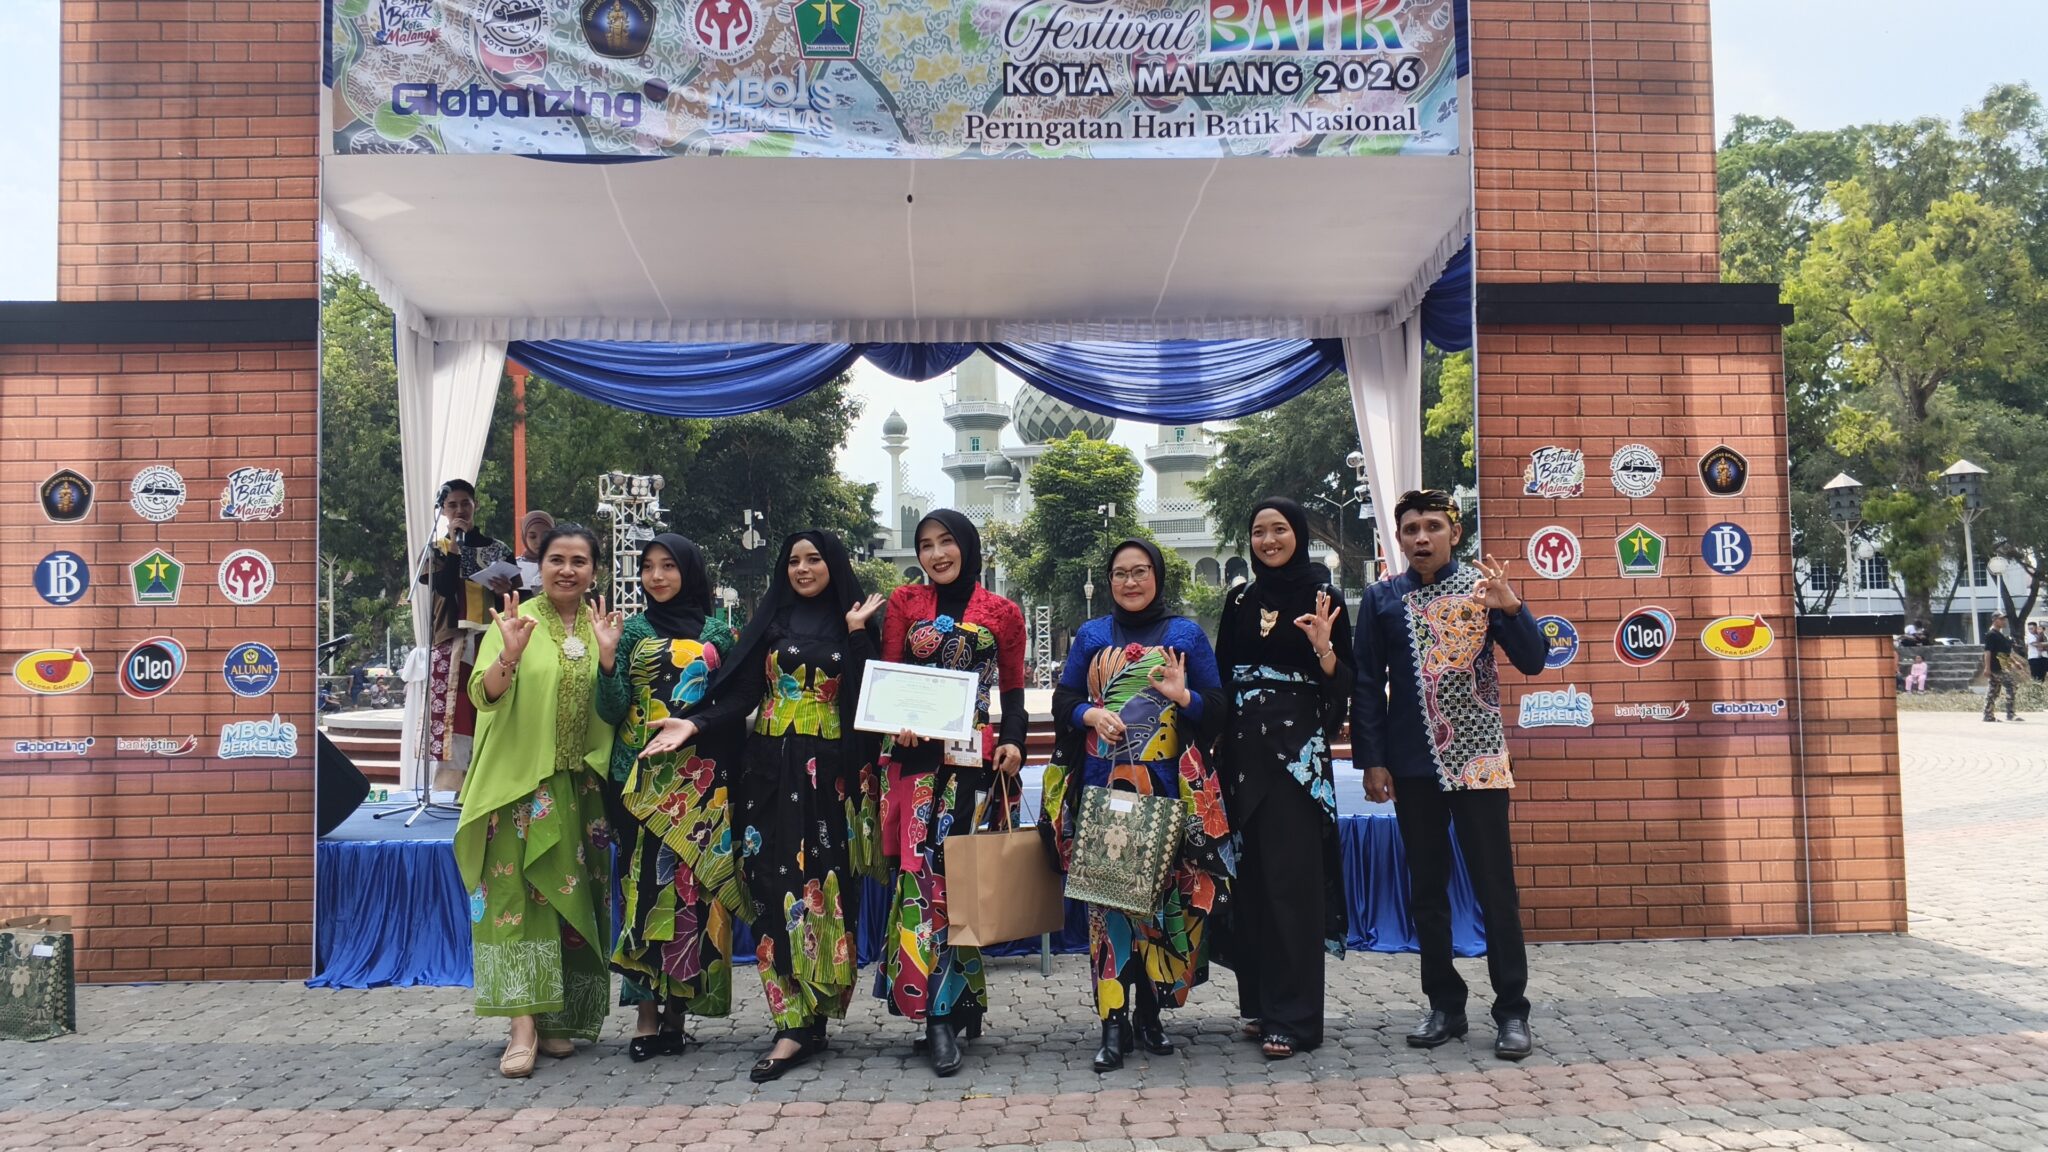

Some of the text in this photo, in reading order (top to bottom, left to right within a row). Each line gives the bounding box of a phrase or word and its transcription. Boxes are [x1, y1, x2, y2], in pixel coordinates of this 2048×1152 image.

[386, 3, 432, 26] Batik
[401, 19, 423, 32] Kota
[1004, 0, 1404, 62] Festival BATIK
[386, 28, 431, 46] Malang
[483, 34, 545, 54] KOTA MALANG
[1004, 57, 1420, 95] KOTA MALANG 2026
[392, 83, 641, 127] Globalizing
[708, 108, 836, 137] BERKELAS
[965, 102, 1418, 146] Peringatan Hari Batik Nasional
[1532, 447, 1580, 464] Festival
[229, 467, 279, 486] Festival
[1539, 462, 1577, 479] Batik
[1537, 481, 1574, 497] Malang
[1550, 475, 1569, 485] Kota
[235, 482, 276, 501] Batik
[233, 503, 273, 519] Malang
[246, 497, 267, 507] Kota
[1628, 625, 1665, 648] Cleo
[134, 656, 172, 680] Cleo
[231, 664, 272, 675] ALUMNI
[1520, 709, 1591, 725] BERKELAS
[220, 740, 295, 757] BERKELAS
